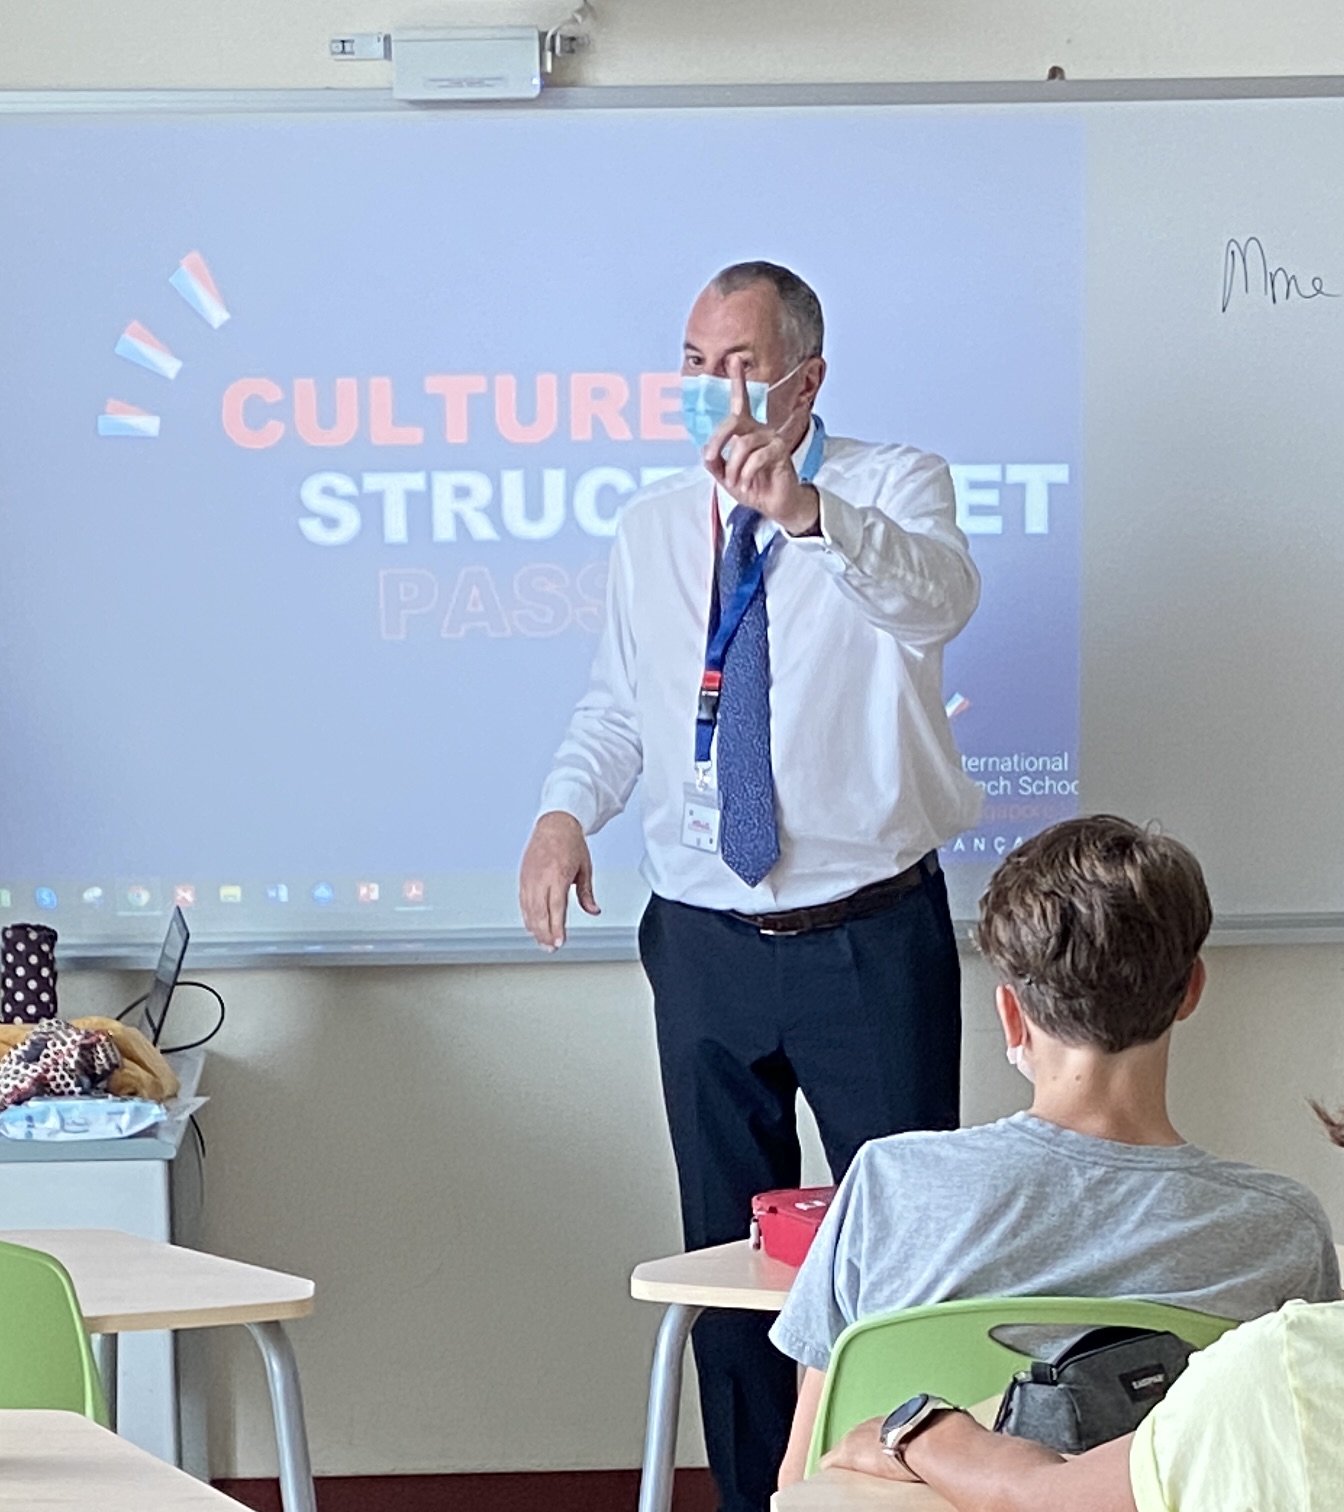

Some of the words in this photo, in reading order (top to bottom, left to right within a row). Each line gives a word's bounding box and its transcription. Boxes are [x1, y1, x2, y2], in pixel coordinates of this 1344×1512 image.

[1221, 236, 1343, 313] Mme
[221, 372, 688, 449] CULTURE
[298, 464, 688, 547] STRUC
[378, 562, 609, 641] PASS
[961, 751, 1069, 772] ternational
[1018, 776, 1080, 796] Schoo
